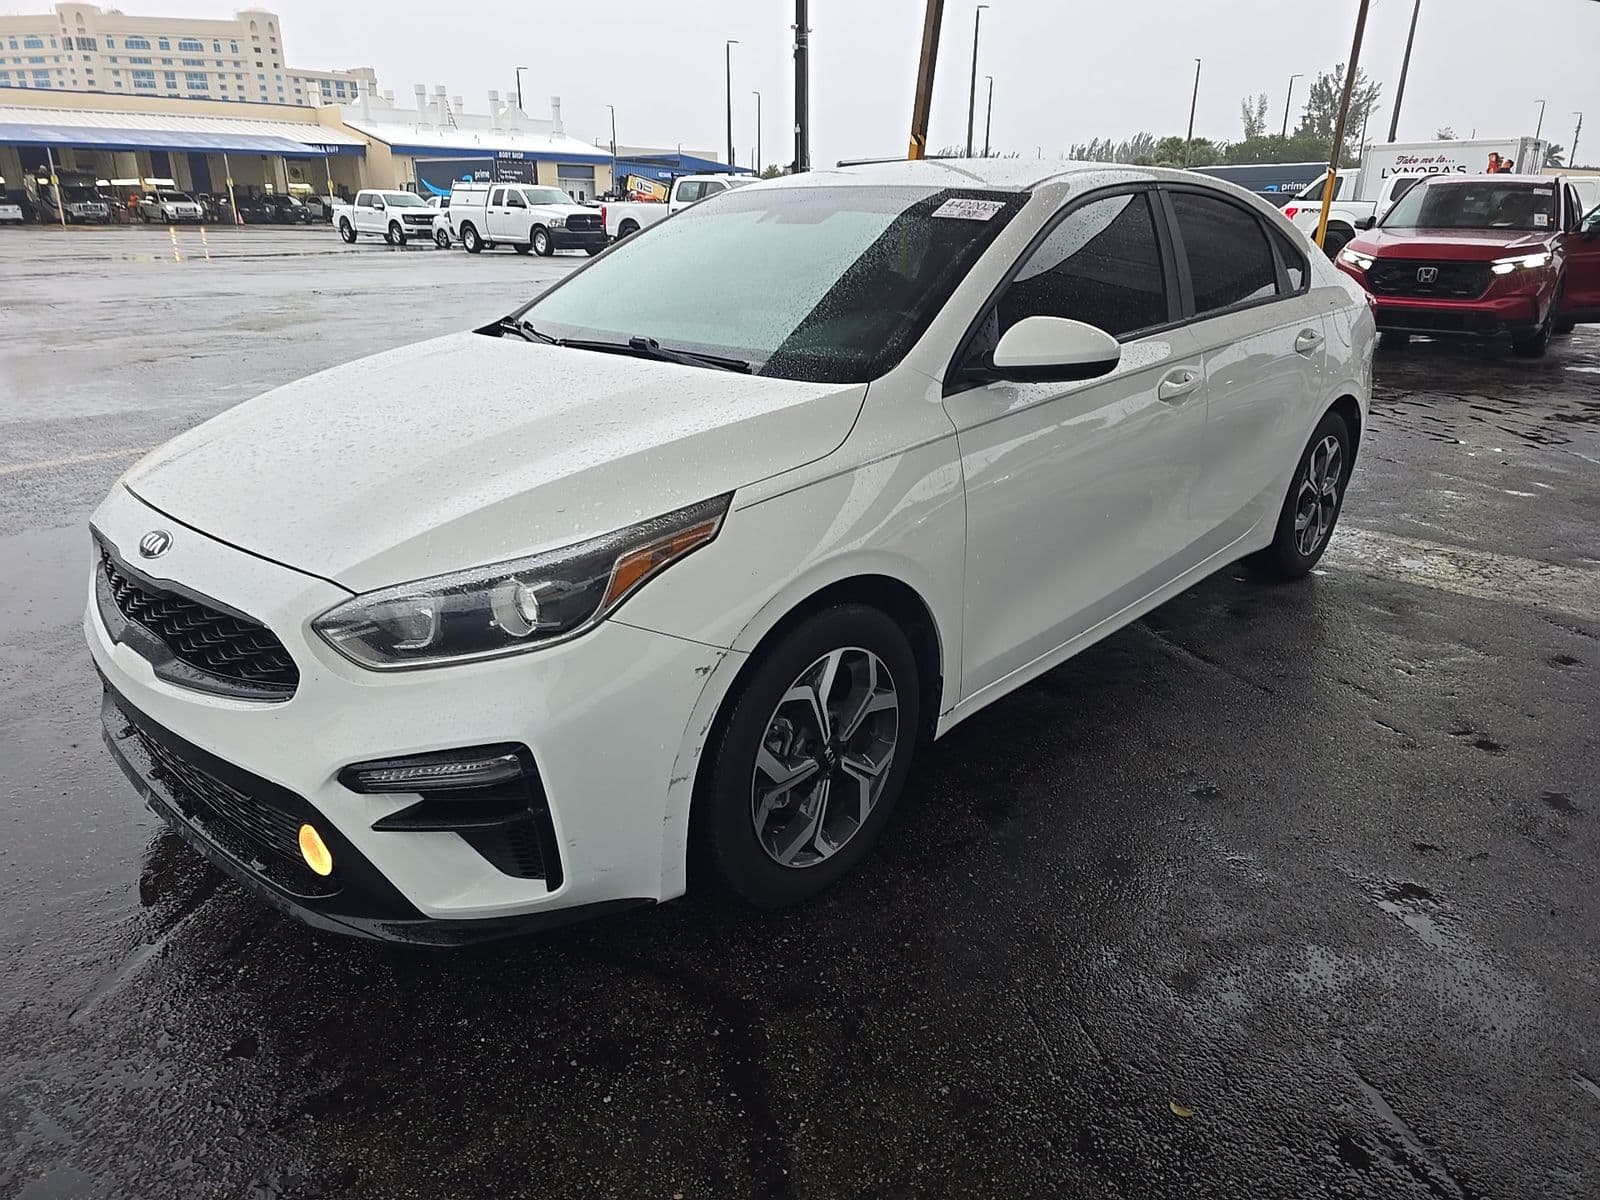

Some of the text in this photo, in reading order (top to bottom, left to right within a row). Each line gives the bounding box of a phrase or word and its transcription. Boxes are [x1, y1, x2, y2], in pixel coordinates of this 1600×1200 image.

[1395, 154, 1419, 165] Take
[1420, 157, 1434, 165] me
[474, 169, 490, 181] prime
[1281, 181, 1307, 192] prime
